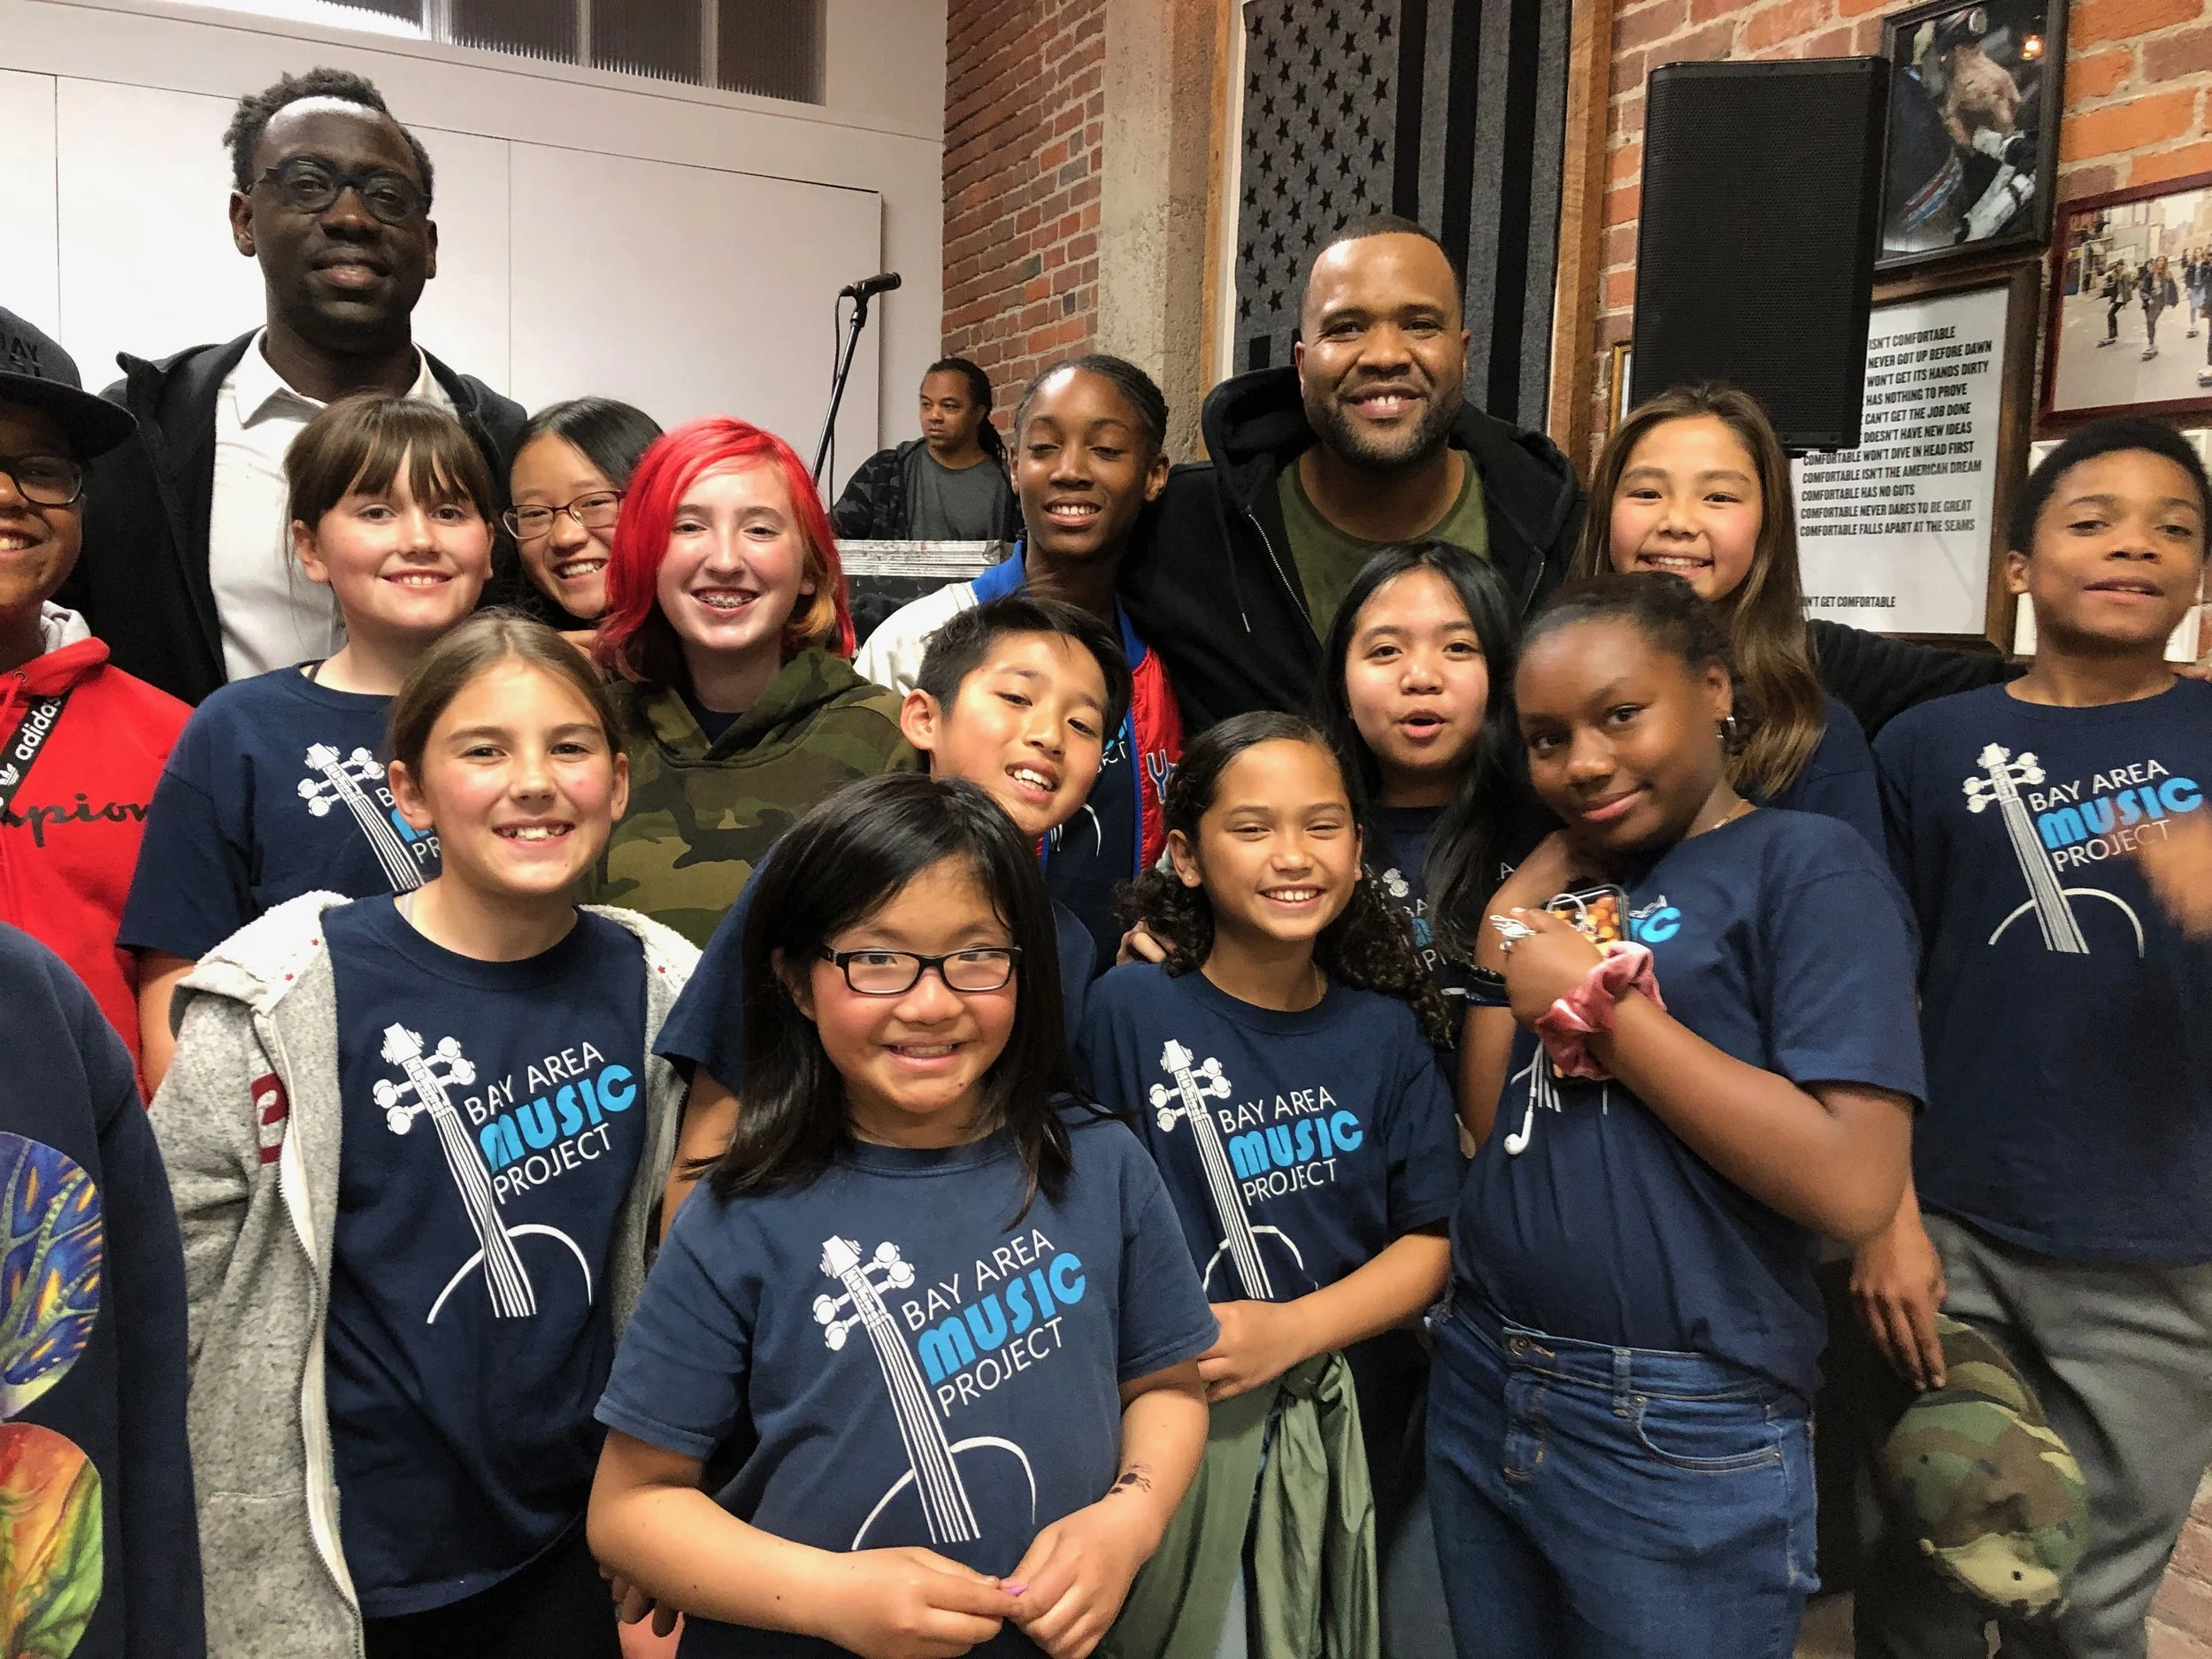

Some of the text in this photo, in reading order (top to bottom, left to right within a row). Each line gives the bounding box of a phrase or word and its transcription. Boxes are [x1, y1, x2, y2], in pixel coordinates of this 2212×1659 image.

[1868, 340, 1993, 369] NEVER GOT UP BEFORE DAWN
[1869, 326, 1956, 350] ISN'T COMFORTABLE
[1866, 382, 1968, 406] HAS NOTHING TO PROVE
[1867, 360, 1989, 388] WON'T GET ITS HANDS DIRTY
[1863, 428, 1899, 443] DOESN'T
[1901, 426, 1923, 440] HAVE
[1924, 424, 1945, 437] NEW
[1946, 421, 1972, 436] IDEAS
[1865, 402, 1971, 425] CAN'T GET THE JOB DONE
[1802, 460, 1982, 484] COMFORTABLE ISN'T THE AMERICAN DREAM
[1803, 441, 1974, 466] COMFORTABLE WON'T DIVE IN HEAD FIRST
[1801, 484, 1916, 502] COMFORTABLE HAS NO GUTS
[1801, 499, 1972, 519] COMFORTABLE NEVER DARES TO BE GREAT
[1800, 518, 1975, 537] COMFORTABLE FALLS APART AT THE SEAMS
[1820, 596, 1836, 607] GET
[1837, 596, 1896, 608] COMFORTABLE
[15, 696, 61, 760] adidas
[2028, 759, 2170, 812] BAY AREA
[2037, 777, 2203, 849] MUSIC
[2052, 819, 2170, 872] PROJECT
[464, 1041, 605, 1125] BAY AREA
[480, 1064, 637, 1174] MUSIC
[1217, 1086, 1337, 1133] BAY AREA
[493, 1122, 611, 1204] PROJECT
[1228, 1110, 1363, 1179] MUSIC
[1241, 1158, 1337, 1206] PROJECT
[901, 1228, 1055, 1332] BAY AREA
[918, 1252, 1086, 1386] MUSIC
[936, 1316, 1062, 1418] PROJECT
